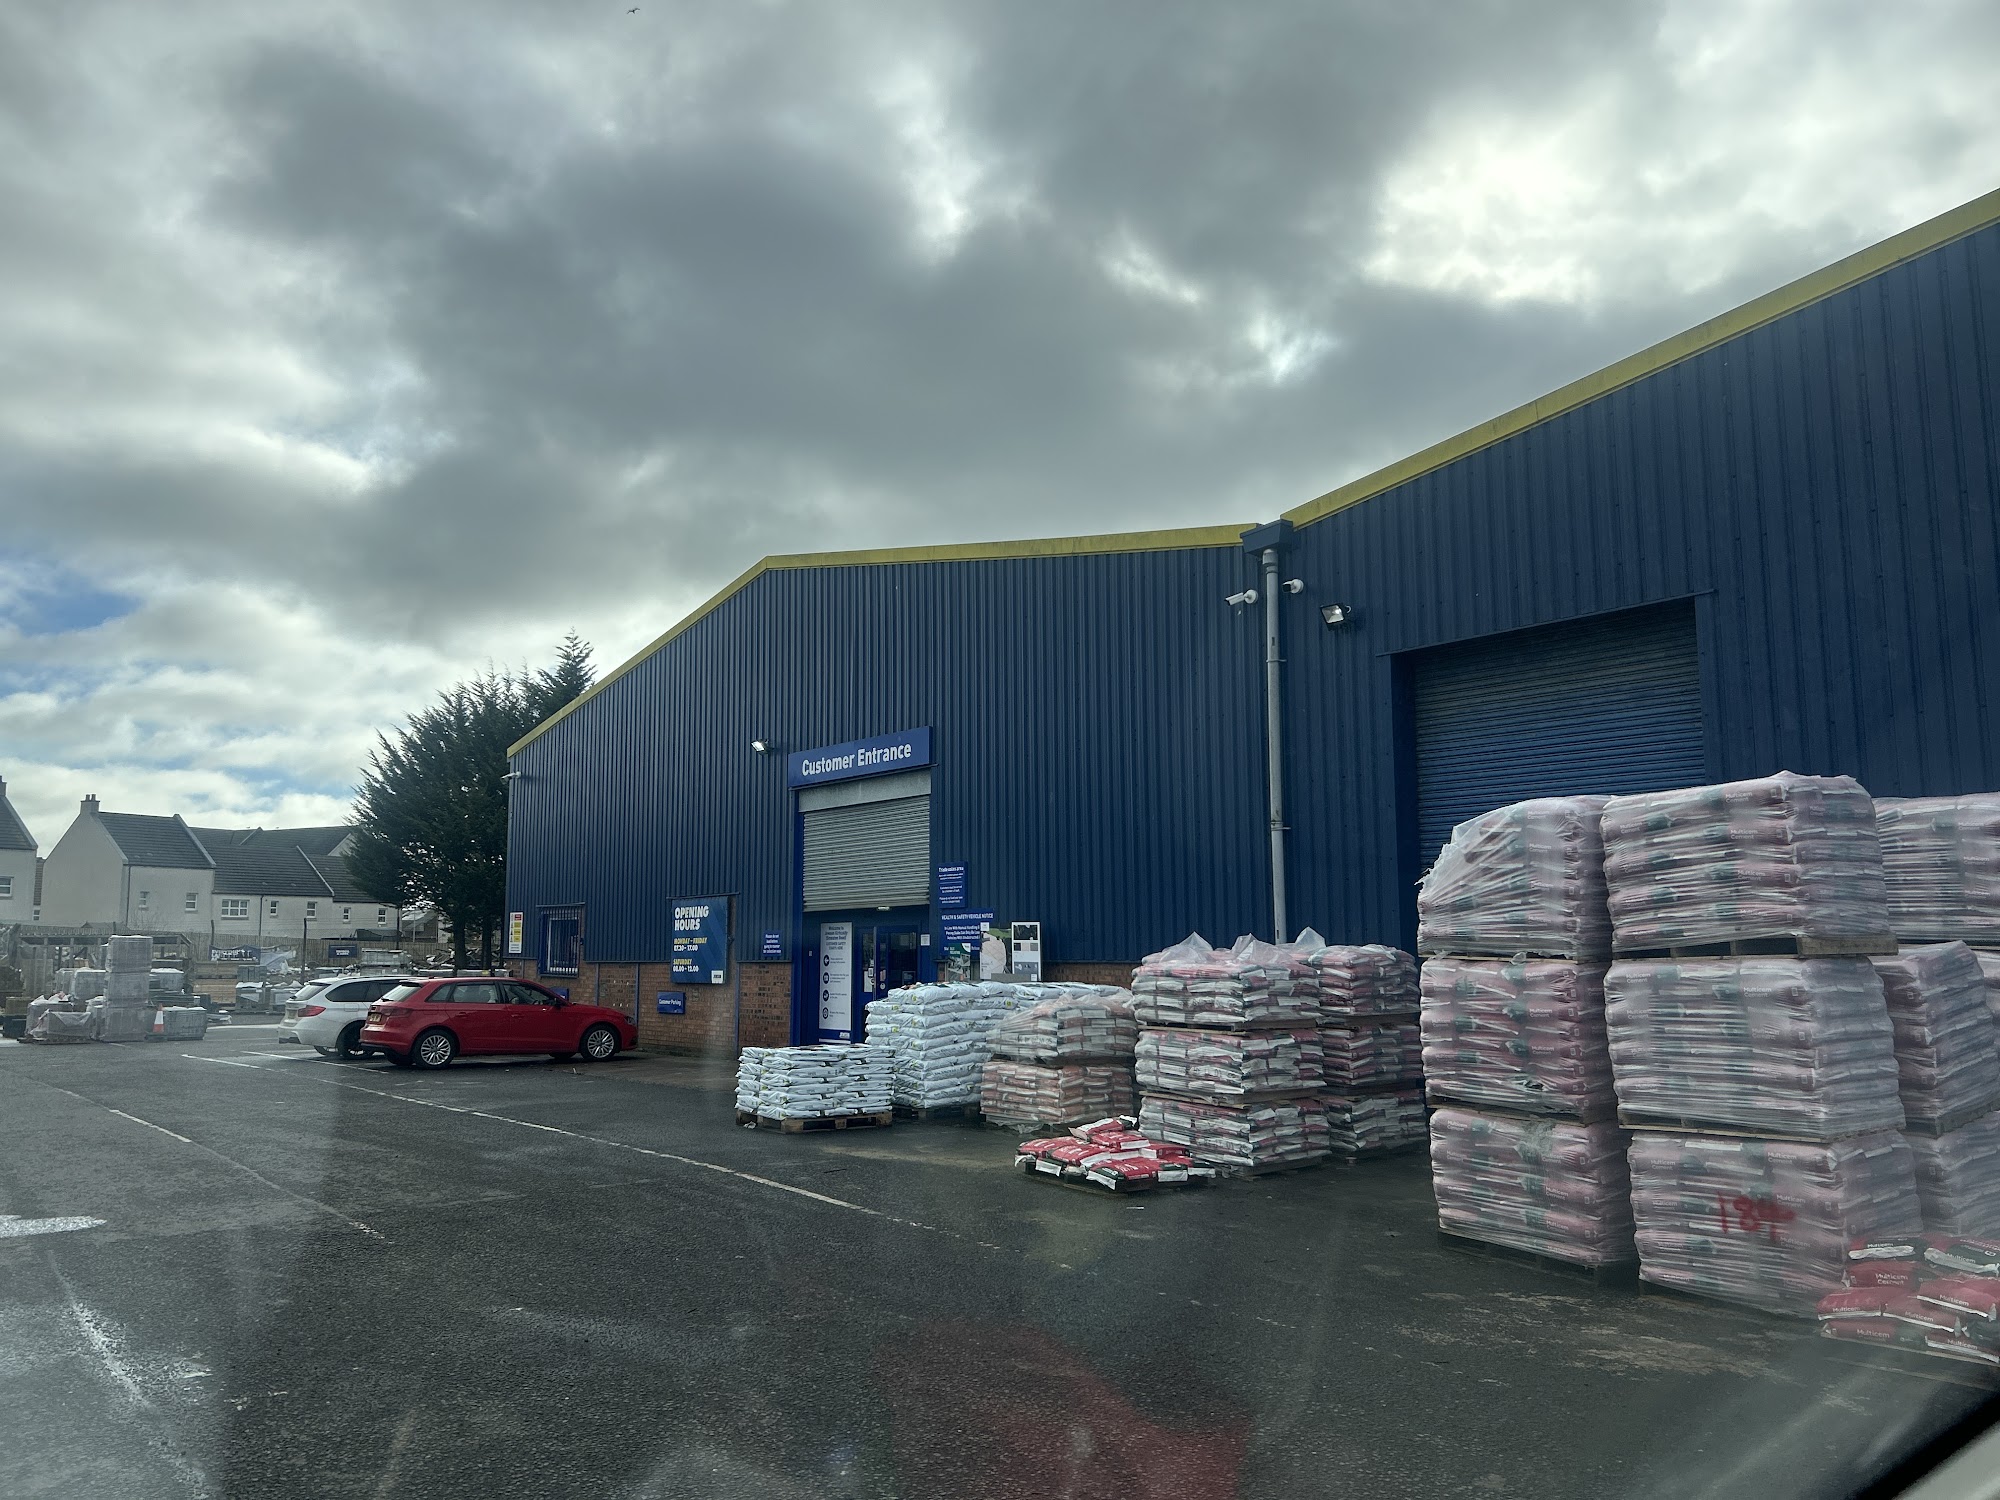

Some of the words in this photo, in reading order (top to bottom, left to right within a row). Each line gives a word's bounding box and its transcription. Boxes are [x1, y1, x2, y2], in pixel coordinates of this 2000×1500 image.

[802, 753, 855, 776] Customer
[857, 743, 912, 767] Entrance
[674, 906, 709, 919] OPENING
[674, 919, 701, 931] HOURS
[1546, 1187, 1568, 1196] Multicem
[1546, 1192, 1565, 1200] Cement
[1776, 1194, 1806, 1203] Multicem
[1547, 1220, 1569, 1230] Multicem
[1948, 1253, 1976, 1263] Multicem
[1940, 1294, 1970, 1306] Multicem
[1905, 1311, 1934, 1322] Multicem
[1857, 1329, 1890, 1338] Multicem
[1947, 1339, 1978, 1350] Multicem
